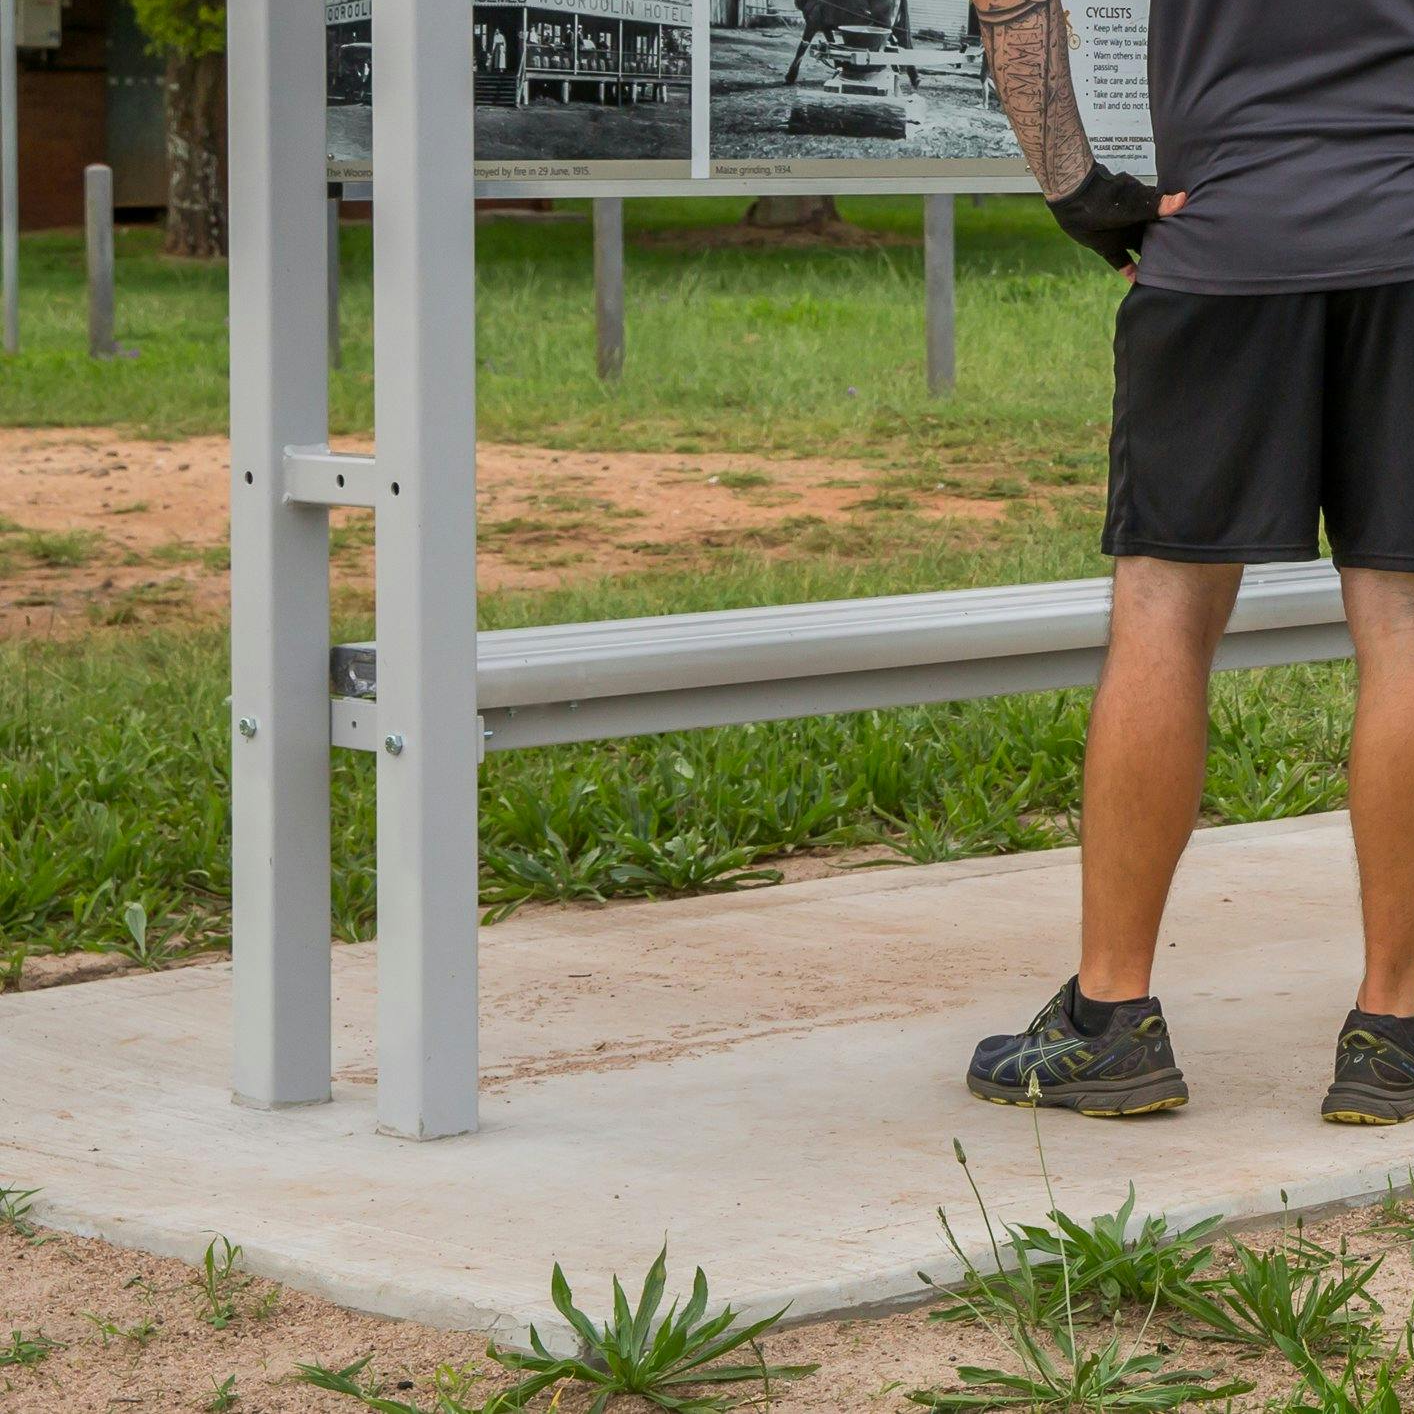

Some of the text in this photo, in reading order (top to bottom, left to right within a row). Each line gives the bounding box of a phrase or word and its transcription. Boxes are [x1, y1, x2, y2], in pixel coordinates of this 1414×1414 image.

[643, 2, 689, 24] HOTEL
[1086, 6, 1132, 20] CYCLISTS
[1093, 23, 1110, 34] Keep
[1111, 23, 1123, 32] left
[1124, 23, 1137, 33] and
[1092, 37, 1132, 48] Give way to
[1093, 50, 1143, 61] Warn others in
[1093, 62, 1118, 73] passing
[1092, 75, 1138, 86] Take care and
[1093, 89, 1108, 98] Take
[1124, 90, 1137, 98] and
[1092, 100, 1144, 111] trail and do not
[501, 166, 512, 178] by
[513, 165, 527, 176] fire
[526, 165, 537, 176] in
[536, 165, 549, 178] 29
[714, 164, 738, 176] Maize
[738, 164, 773, 176] grinding,
